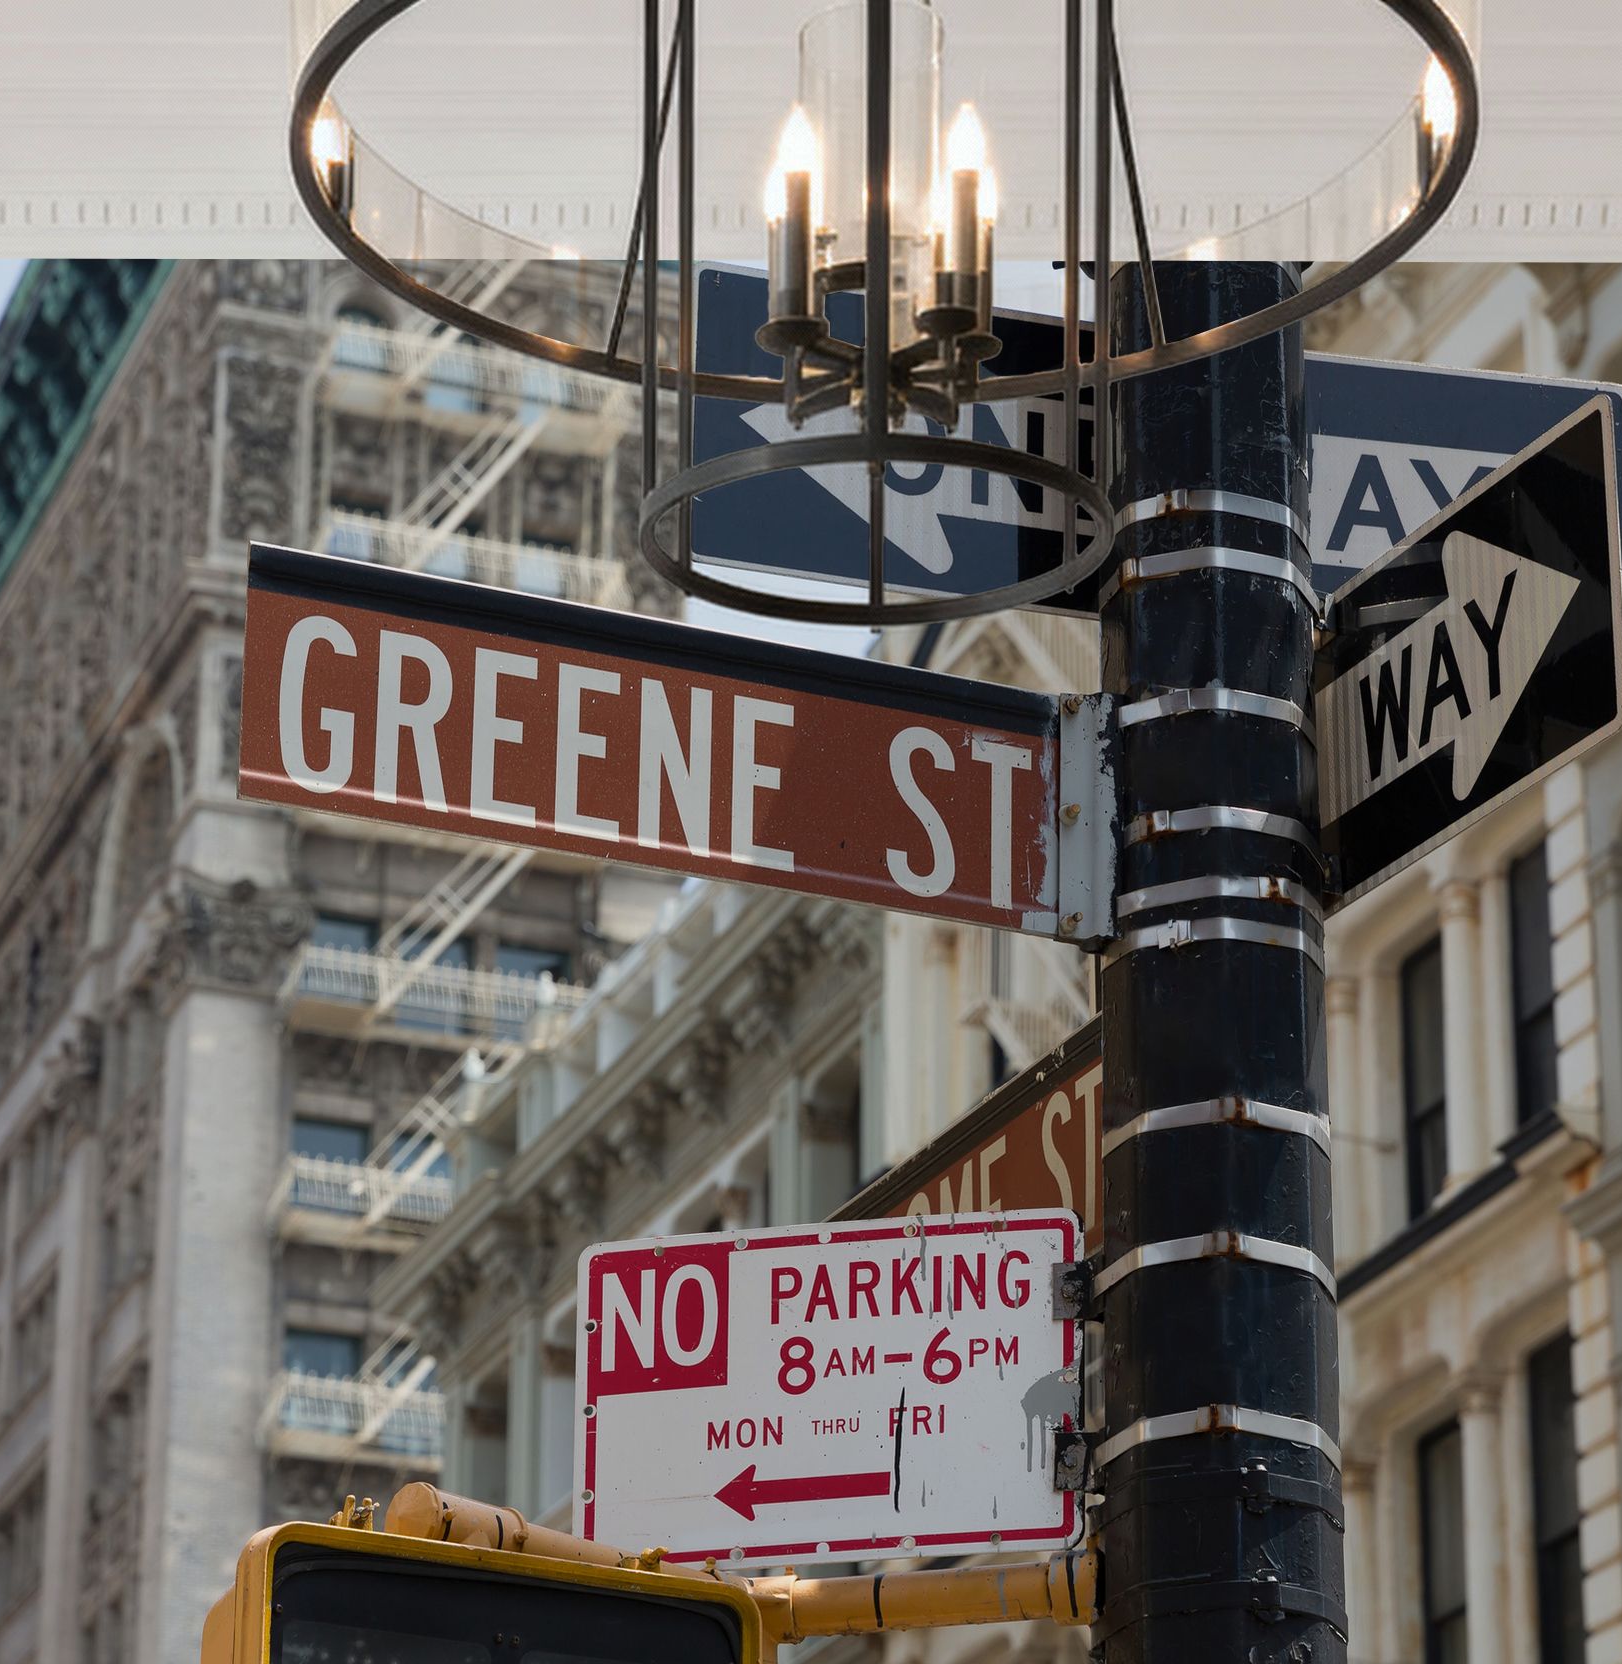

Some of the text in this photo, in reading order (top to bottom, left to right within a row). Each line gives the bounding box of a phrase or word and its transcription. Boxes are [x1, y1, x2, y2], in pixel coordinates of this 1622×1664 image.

[1359, 569, 1517, 782] WAY
[279, 615, 1032, 909] GREENE ST
[1042, 1063, 1103, 1234] ST
[600, 1249, 1031, 1373] NO PARKING
[706, 1404, 947, 1451] MON THRU FRI
